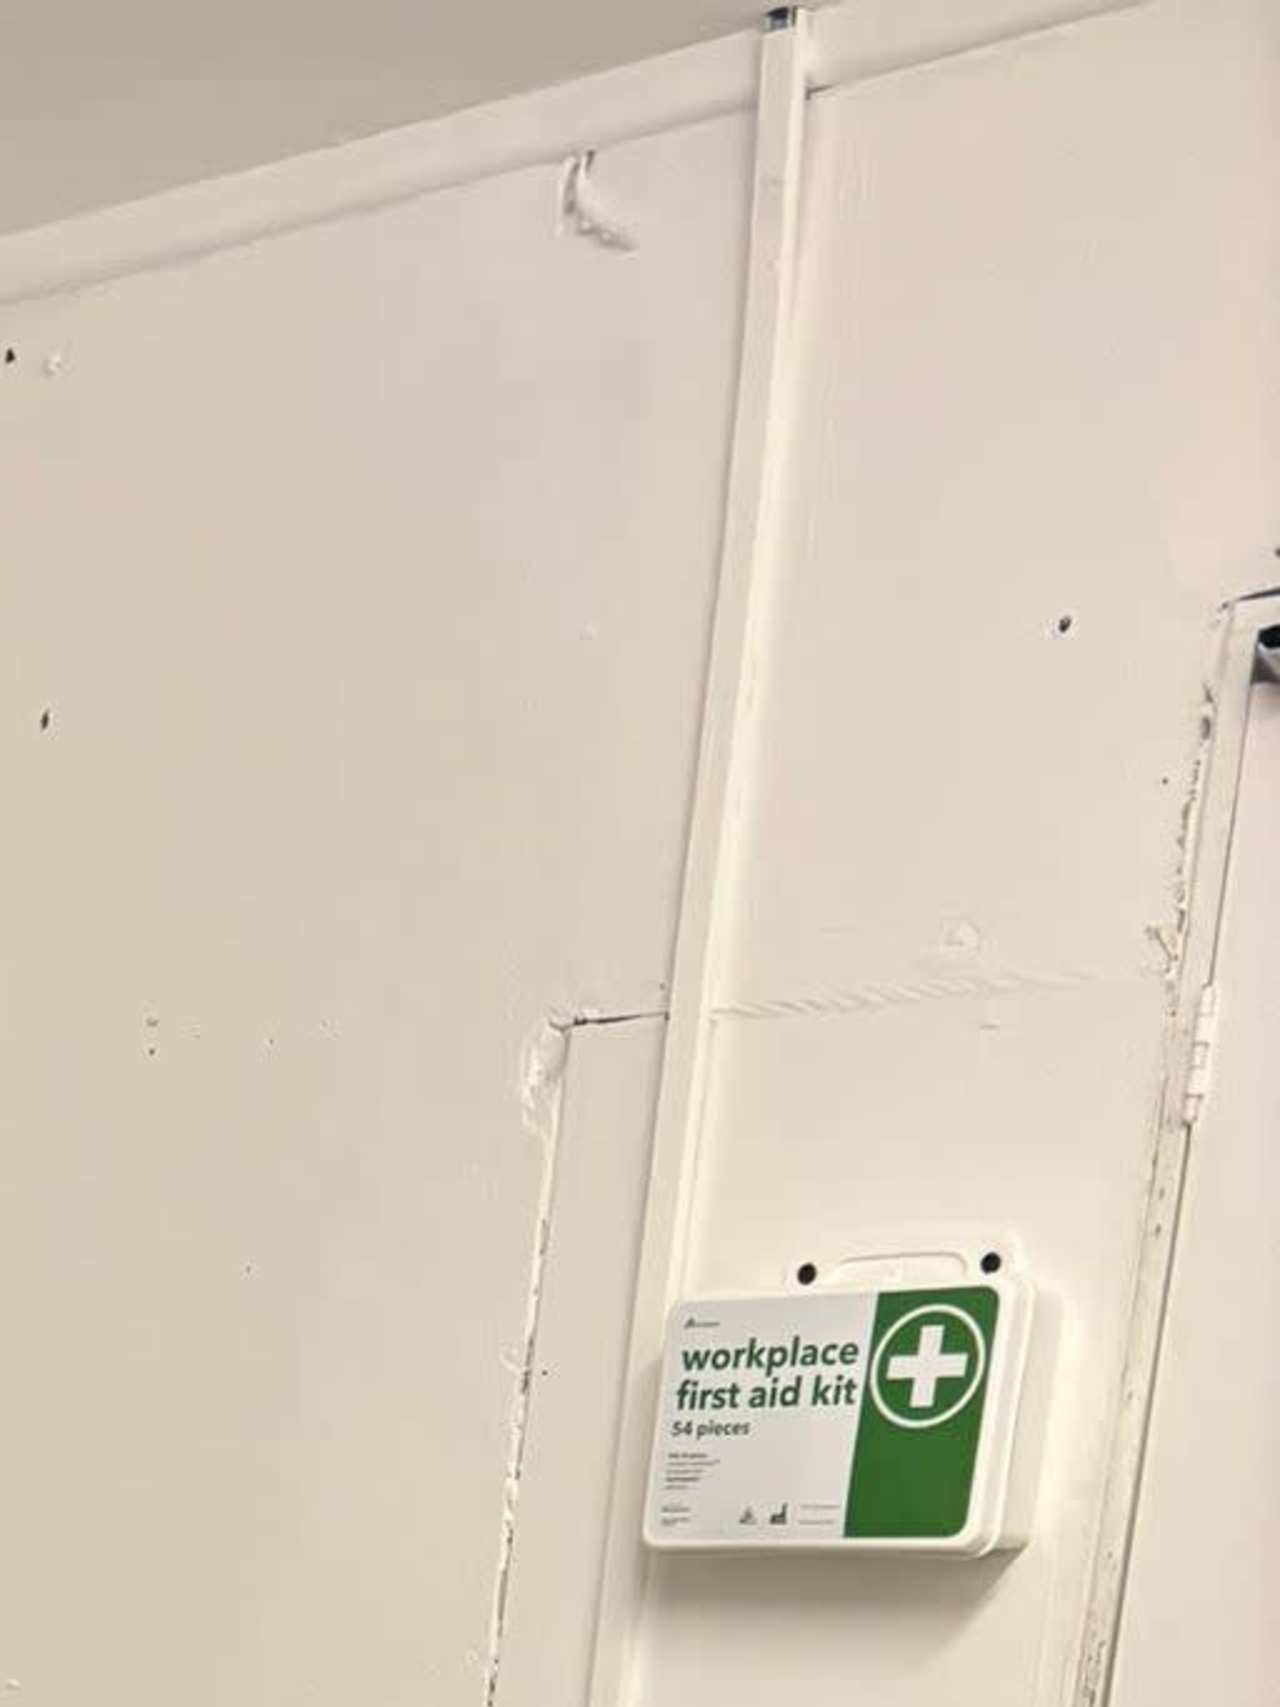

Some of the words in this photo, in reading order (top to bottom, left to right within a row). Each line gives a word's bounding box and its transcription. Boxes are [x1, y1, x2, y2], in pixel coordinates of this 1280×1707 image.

[682, 1335, 859, 1377] workplace
[676, 1378, 740, 1410] first
[747, 1375, 802, 1408] aid
[811, 1374, 858, 1405] kit
[671, 1421, 692, 1437] 54
[696, 1420, 750, 1440] pieces
